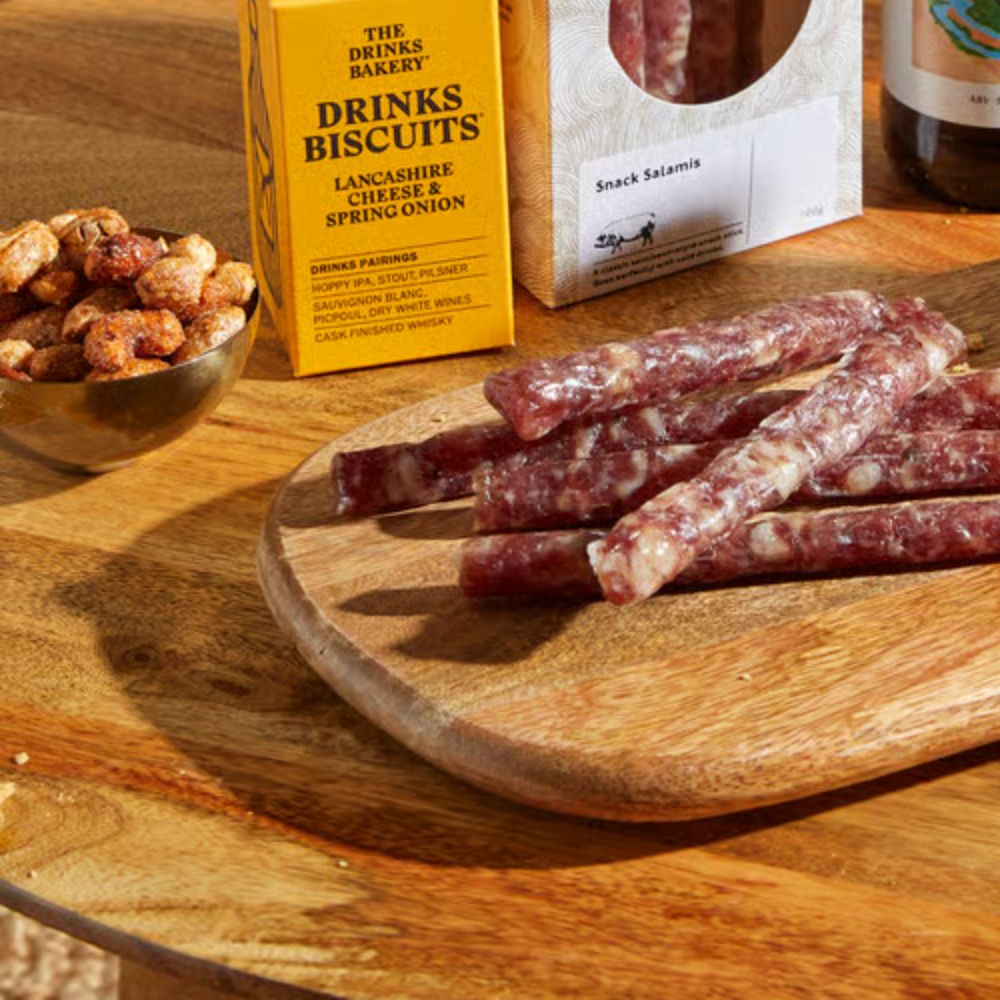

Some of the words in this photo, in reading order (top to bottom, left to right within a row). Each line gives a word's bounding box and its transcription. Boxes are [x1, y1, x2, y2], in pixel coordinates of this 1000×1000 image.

[364, 24, 405, 42] THE
[349, 39, 423, 62] DRINKS
[350, 56, 426, 80] BAKERY
[317, 83, 463, 129] DRINKS
[304, 113, 481, 163] BISCUITS
[334, 162, 454, 191] LANCASHIRE
[595, 172, 639, 193] Snack
[643, 157, 701, 182] Salamis
[347, 184, 424, 207] CHEESE
[428, 181, 442, 196] &
[325, 204, 398, 228] SPRING
[401, 195, 466, 218] ONION
[310, 260, 356, 276] DRINKS
[359, 252, 418, 269] PAIRINGS
[311, 280, 350, 293] HOPPY
[419, 263, 469, 279] PILSNER
[313, 294, 382, 313] SAUVIGNON
[369, 305, 392, 317] DRY
[395, 300, 433, 313] WHITE
[434, 294, 473, 309] WINES
[315, 330, 347, 344] CASK
[350, 322, 405, 338] FINISHED
[407, 315, 453, 331] WHISKY
